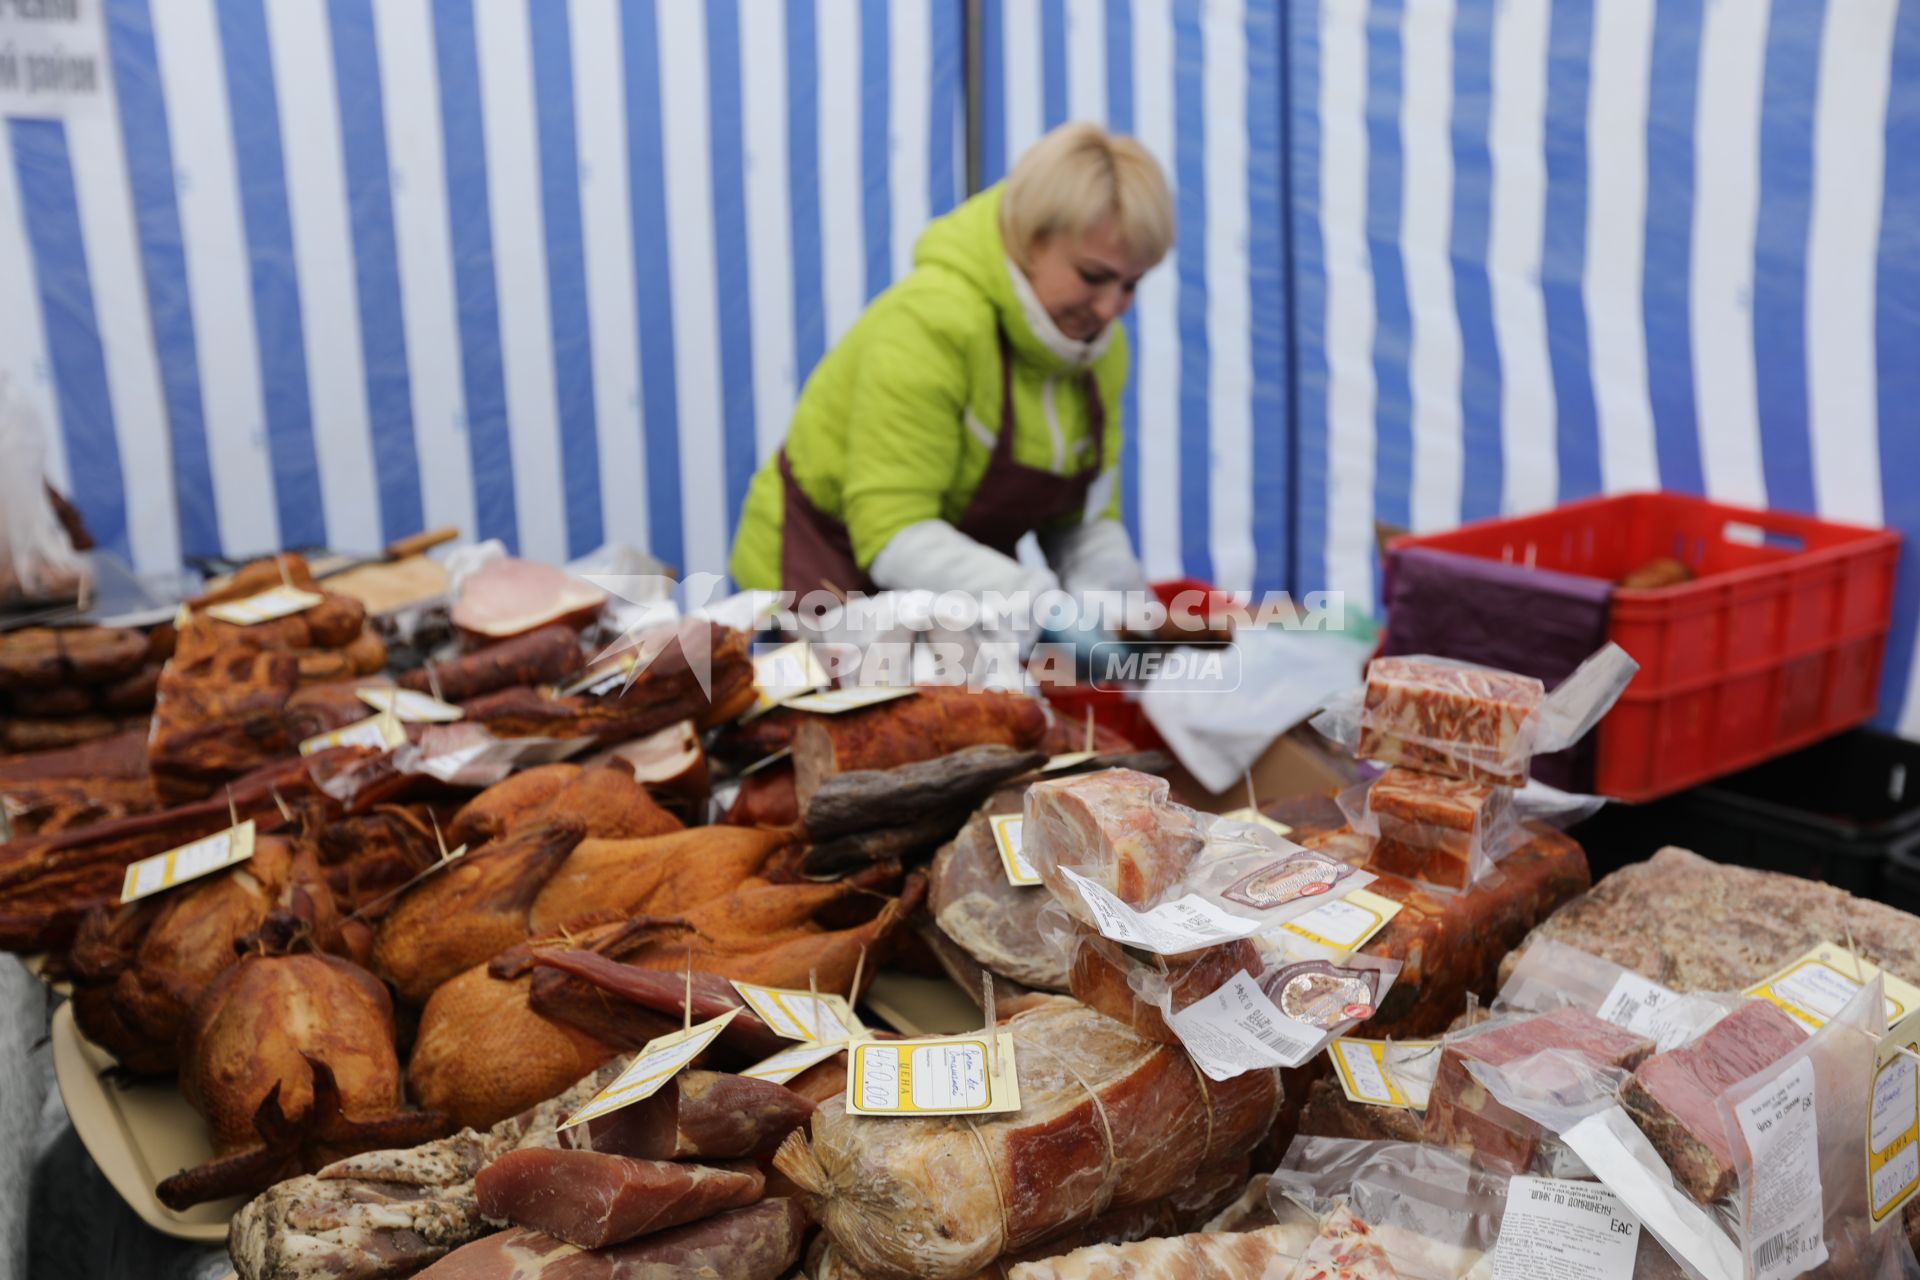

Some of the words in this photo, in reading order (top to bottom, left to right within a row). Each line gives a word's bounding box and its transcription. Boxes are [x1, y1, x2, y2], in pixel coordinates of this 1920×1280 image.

[865, 1049, 897, 1107] 450.00
[900, 1062, 911, 1095] ЦЕНА
[1554, 1194, 1565, 1205] ПО
[1610, 1218, 1633, 1236] EAC
